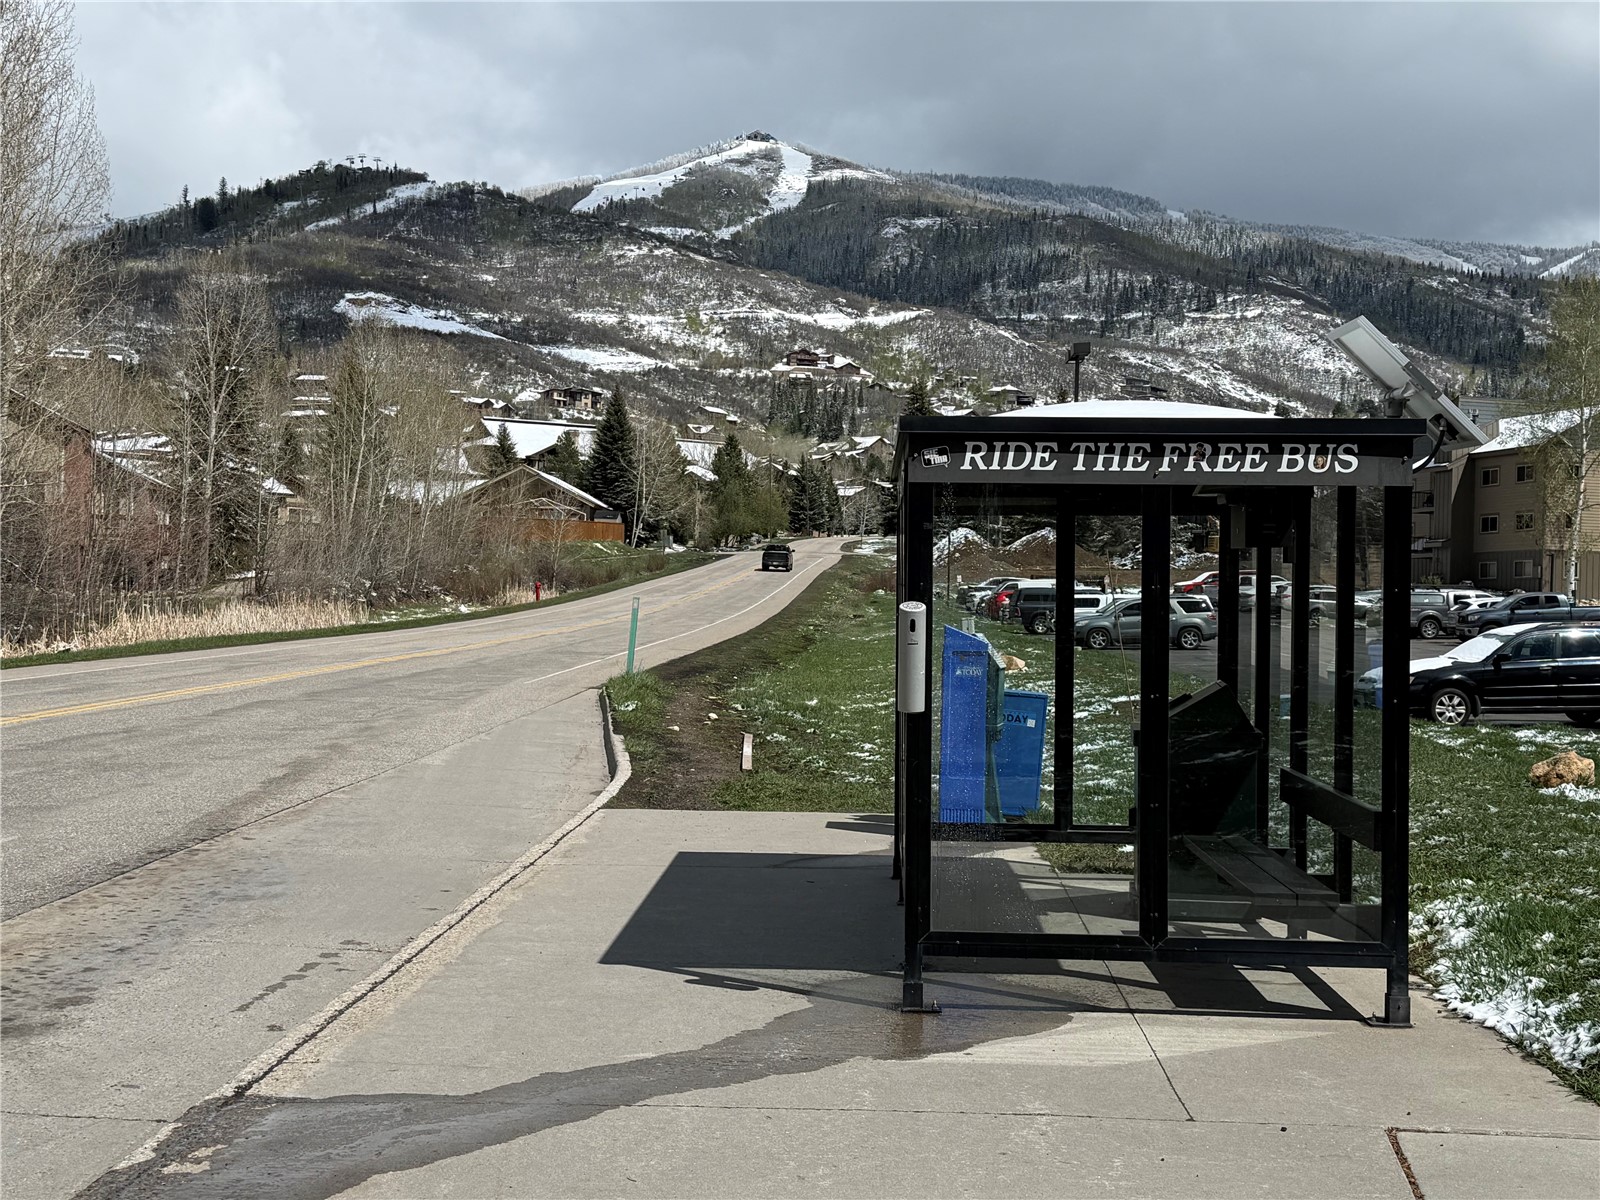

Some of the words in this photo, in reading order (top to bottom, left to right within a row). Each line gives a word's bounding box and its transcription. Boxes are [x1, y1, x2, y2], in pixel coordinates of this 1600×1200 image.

[960, 441, 1058, 471] RIDE
[1070, 442, 1151, 472] THE
[1158, 443, 1270, 473] FREE
[1277, 443, 1359, 474] BUS
